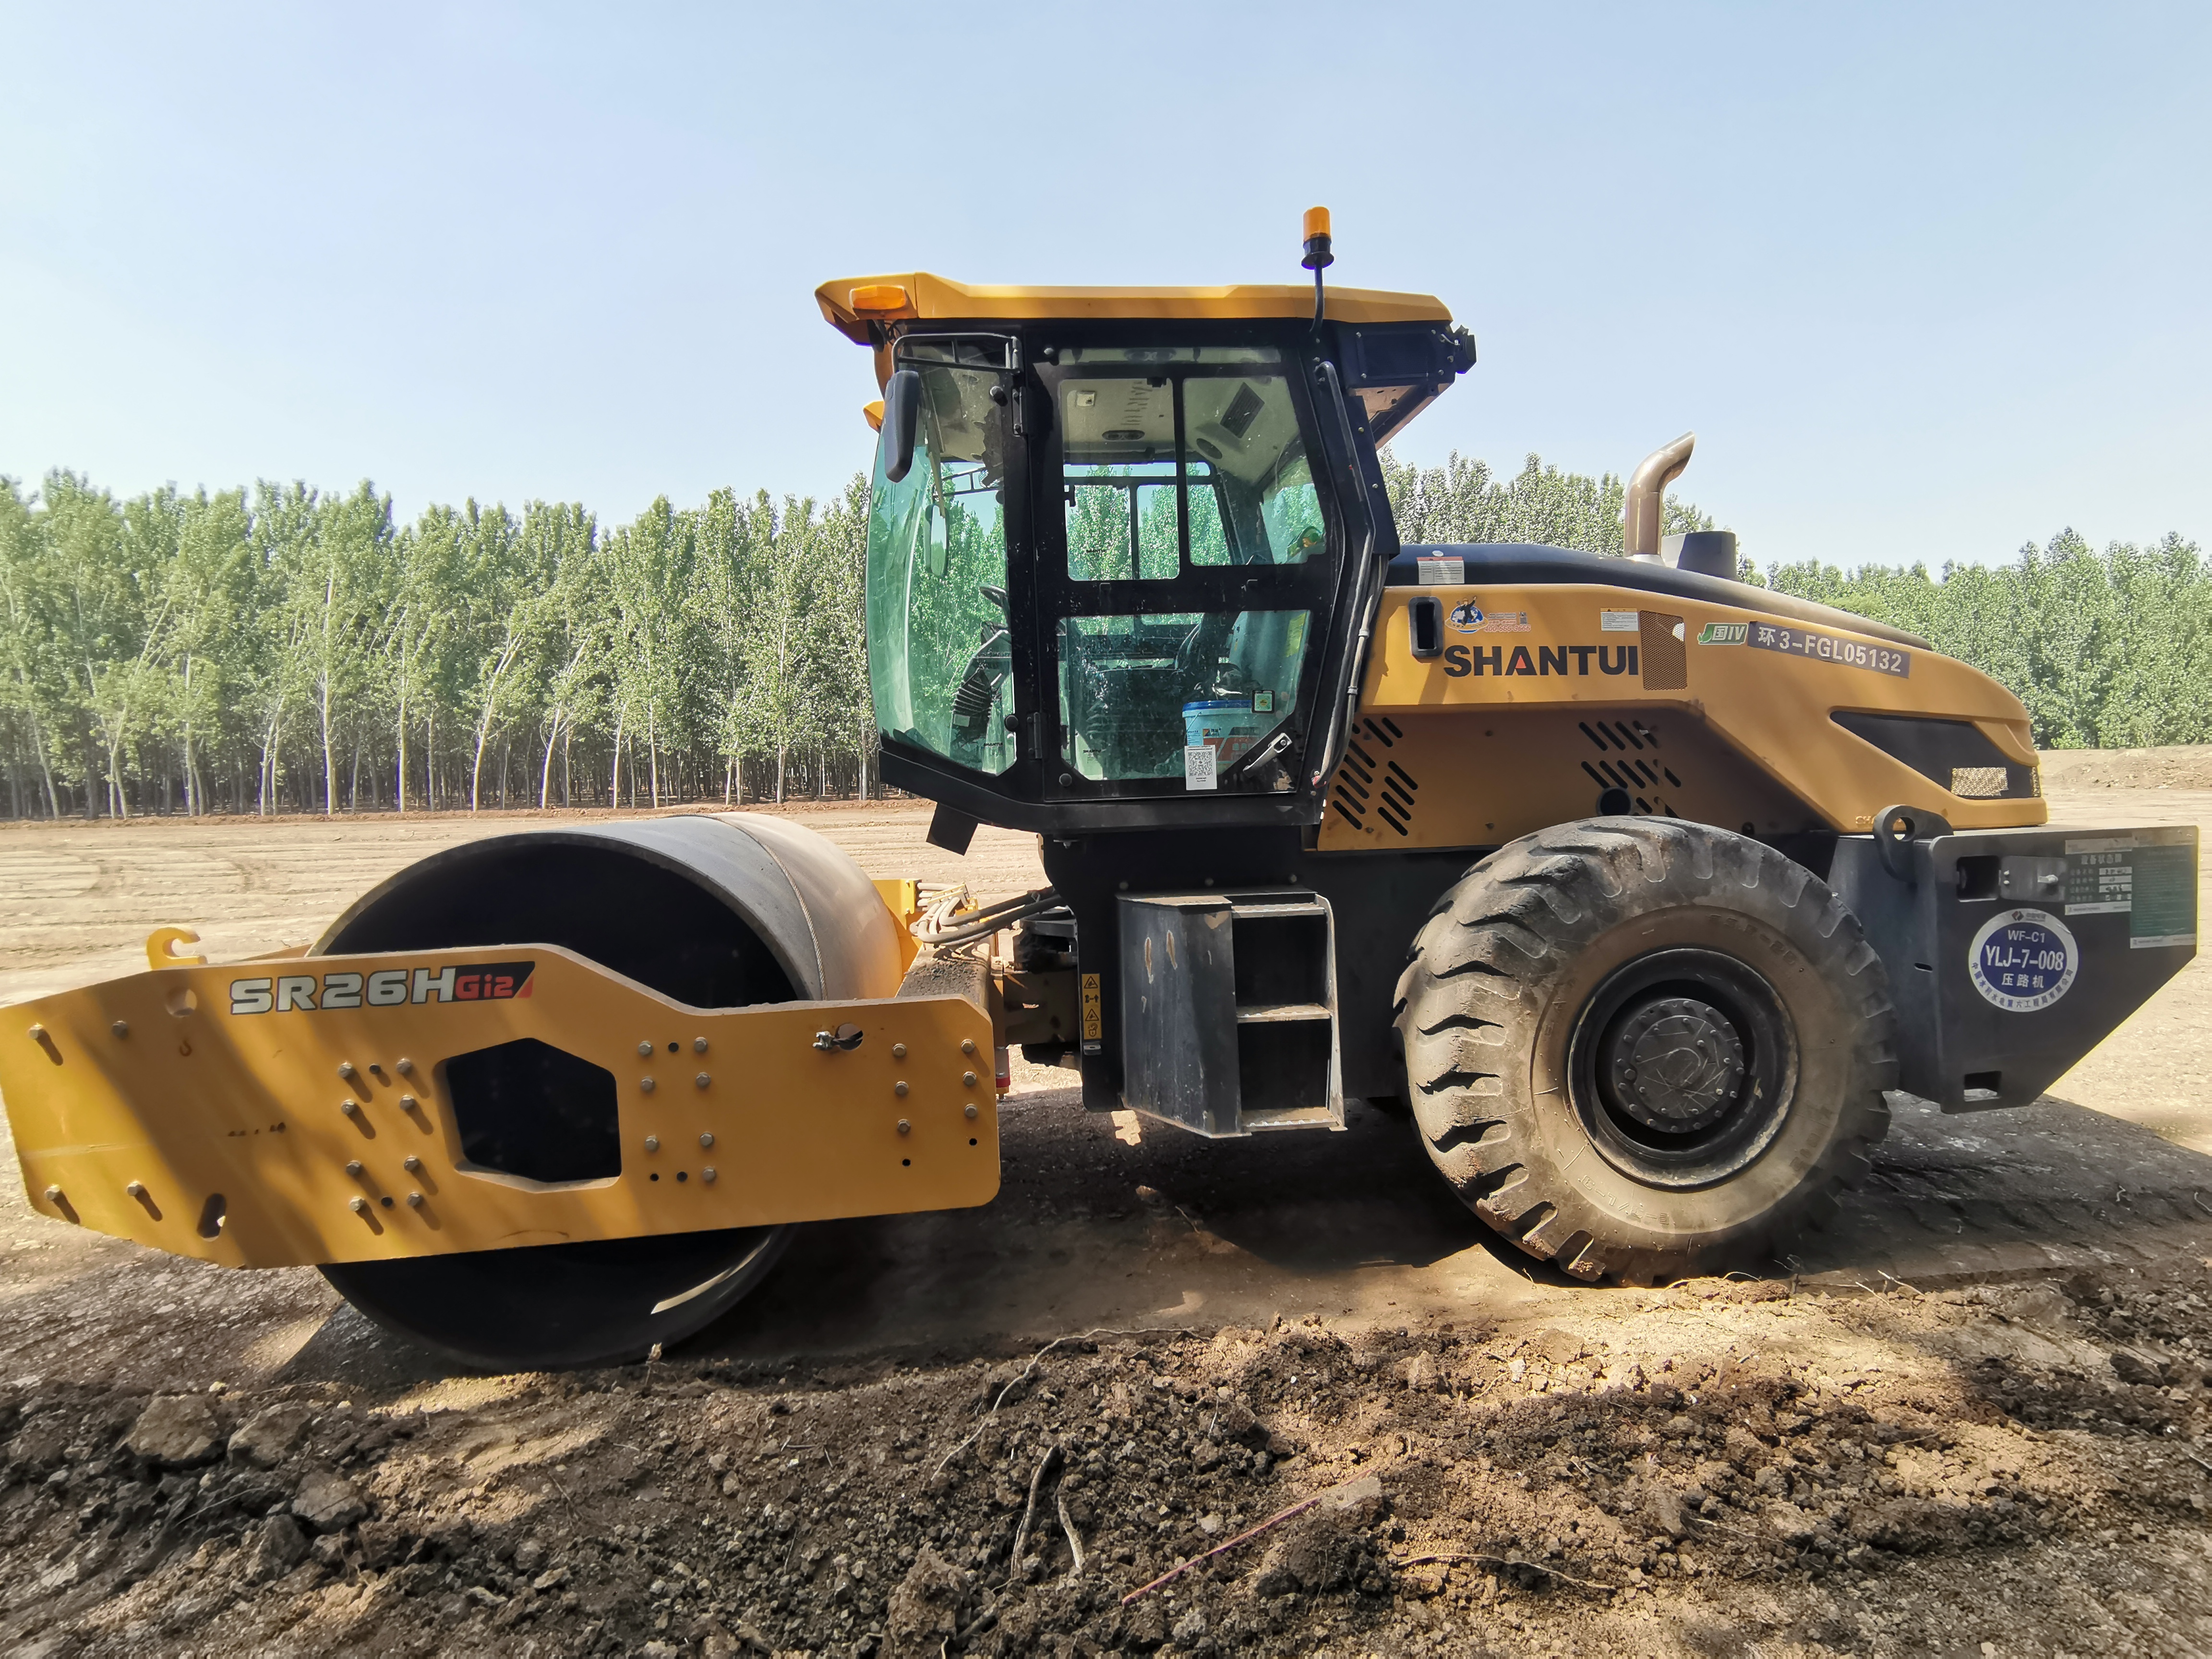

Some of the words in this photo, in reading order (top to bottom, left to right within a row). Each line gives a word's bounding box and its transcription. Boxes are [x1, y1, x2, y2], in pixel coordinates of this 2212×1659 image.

[1712, 625, 1745, 640] 国IV
[1443, 644, 1639, 677] SHANTUI
[2008, 929, 2045, 943] WF-C1
[1985, 945, 2065, 971] YLJ-7-008
[2001, 973, 2044, 988] 压路机
